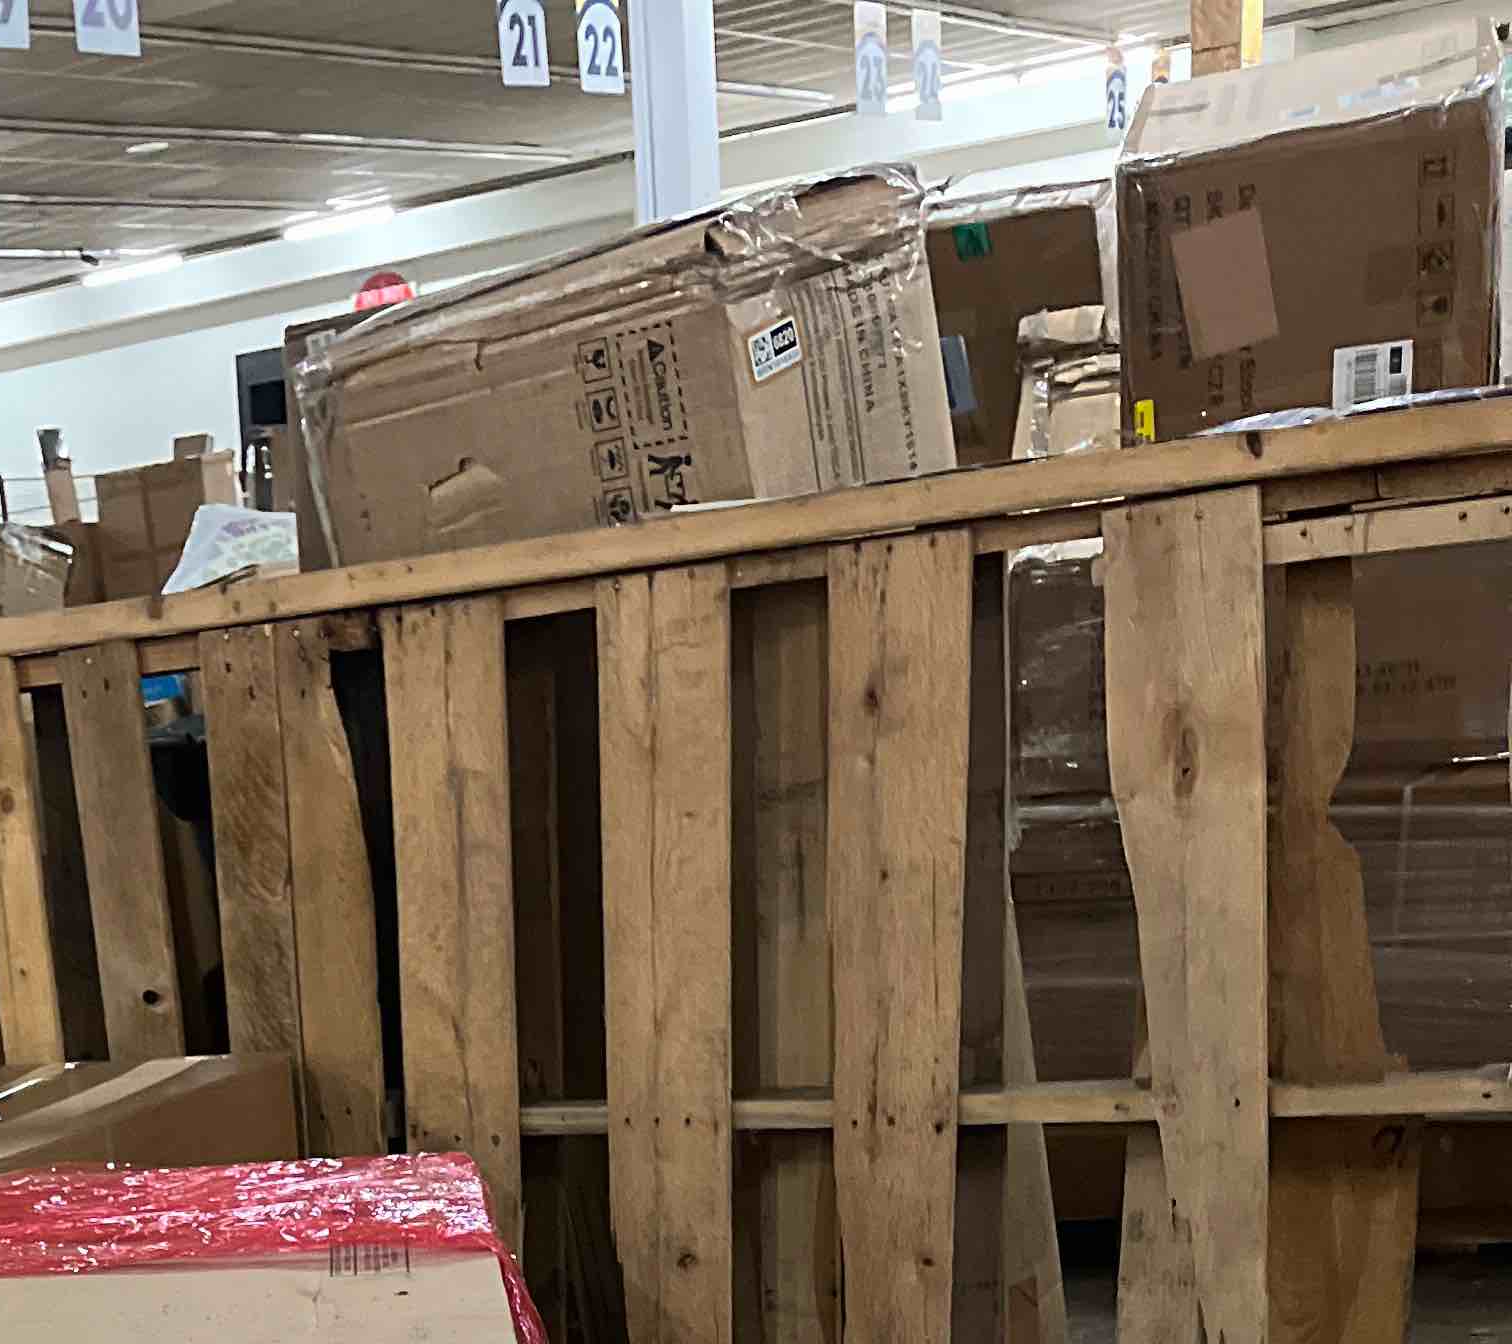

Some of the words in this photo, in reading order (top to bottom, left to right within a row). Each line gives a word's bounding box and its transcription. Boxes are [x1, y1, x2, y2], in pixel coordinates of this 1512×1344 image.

[509, 12, 540, 67] 21
[584, 23, 619, 77] 22
[651, 360, 674, 432] Caution
[858, 348, 876, 413] CHINA
